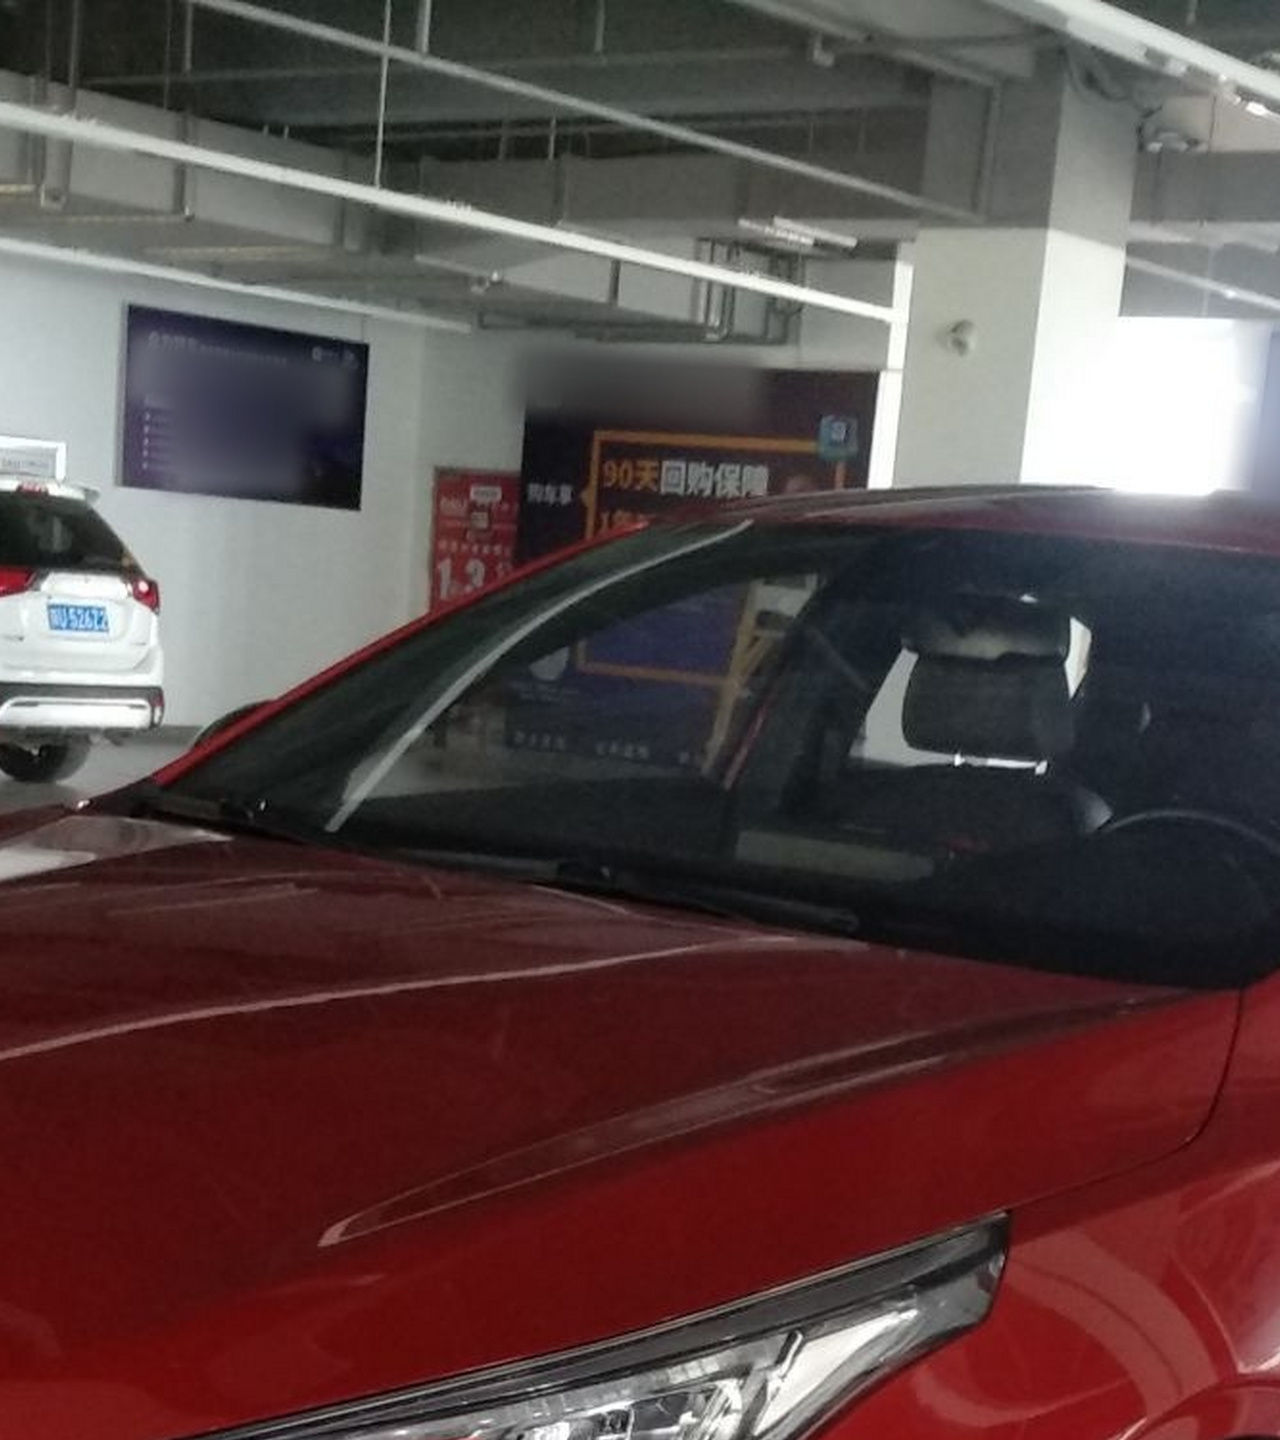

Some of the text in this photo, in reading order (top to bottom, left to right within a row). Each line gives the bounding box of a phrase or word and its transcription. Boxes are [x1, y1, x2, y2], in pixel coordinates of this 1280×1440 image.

[603, 460, 769, 497] 90天回购保障
